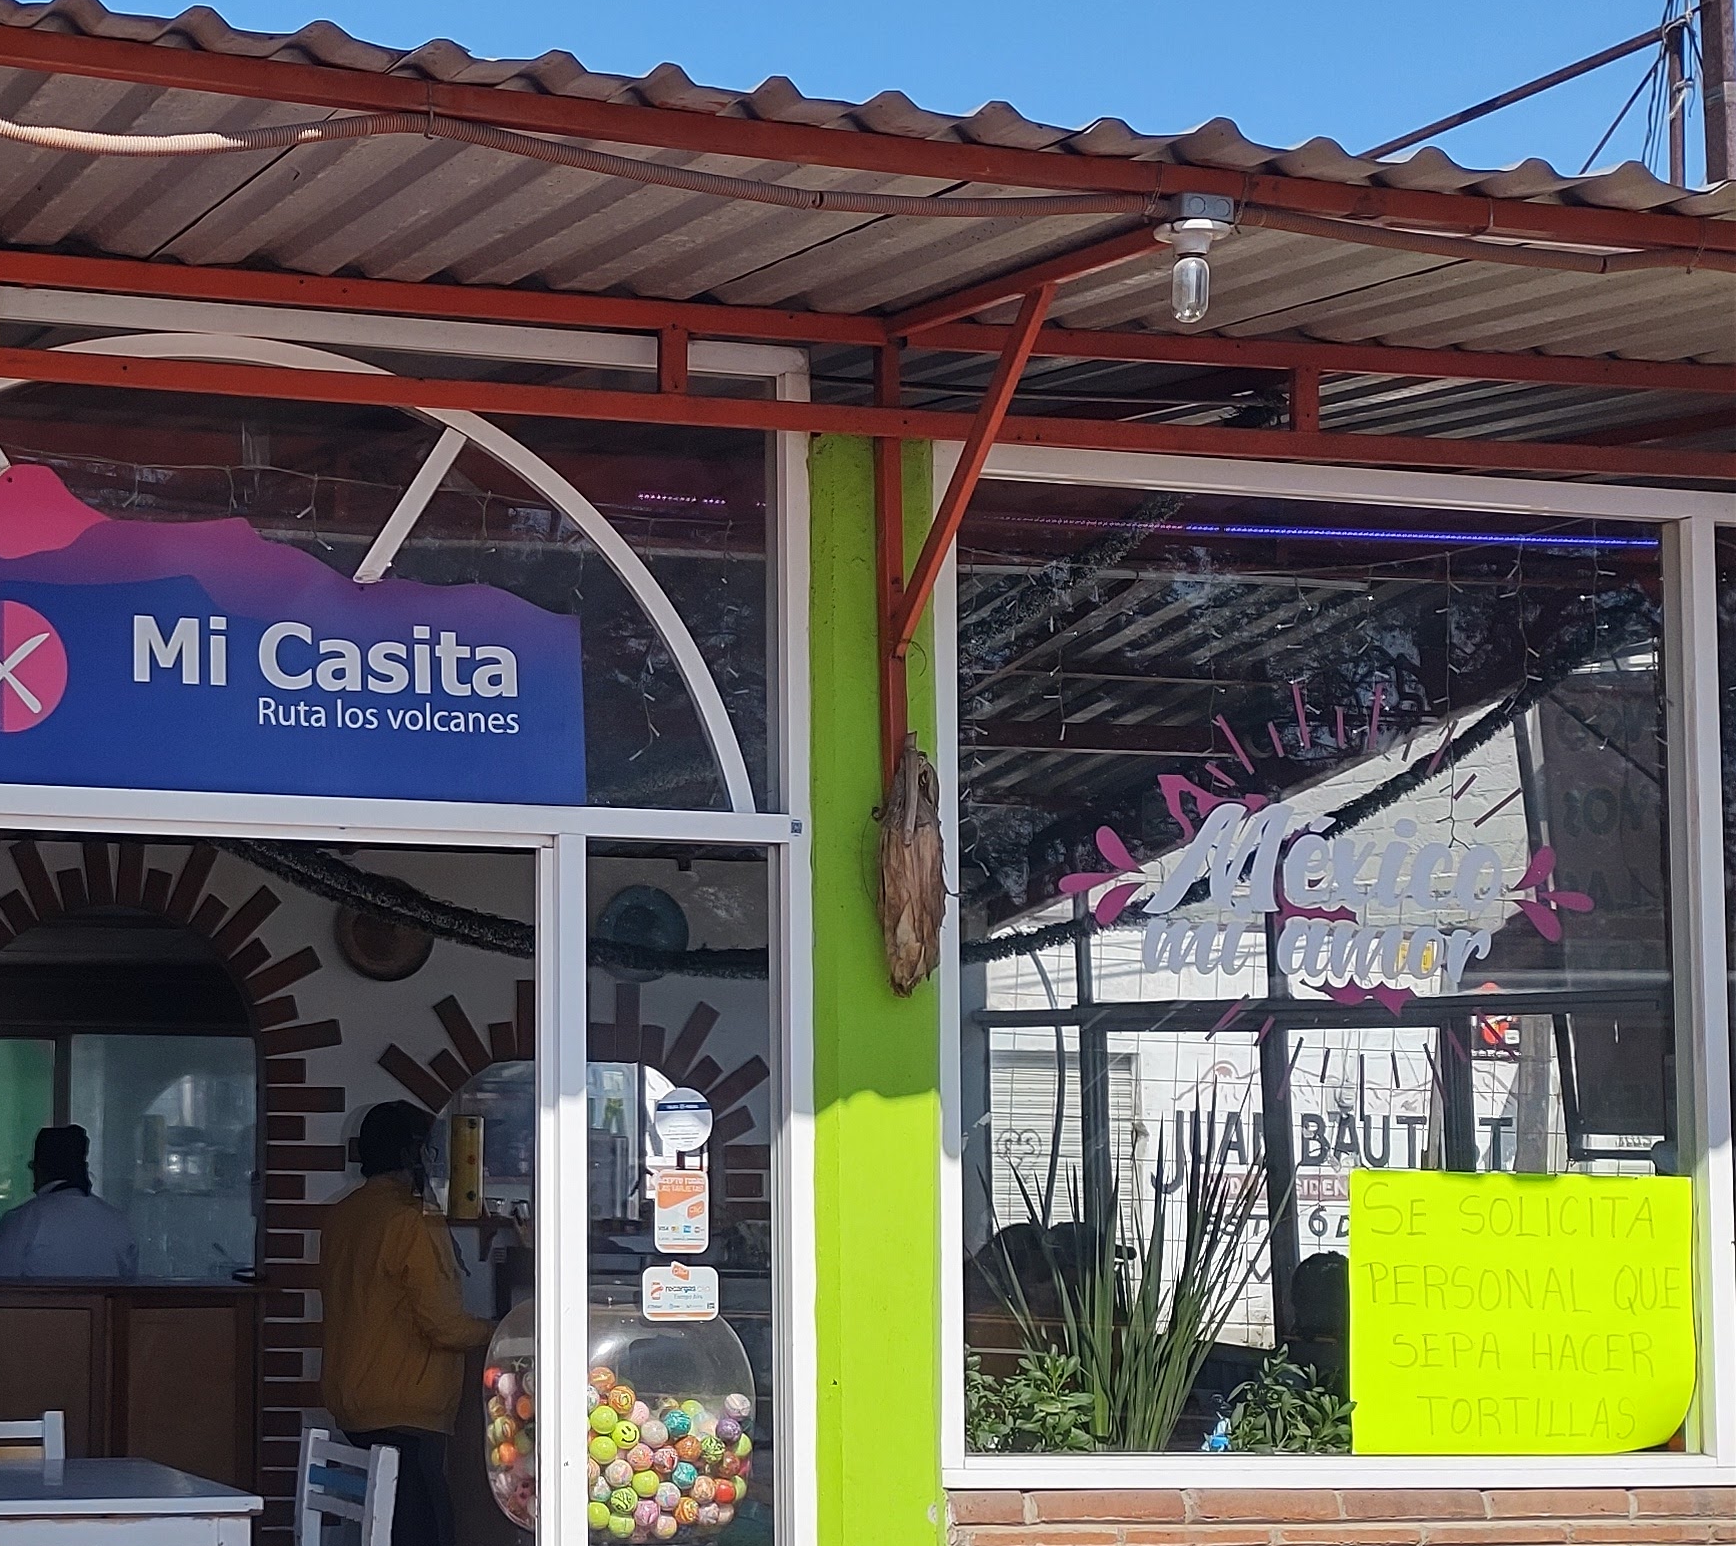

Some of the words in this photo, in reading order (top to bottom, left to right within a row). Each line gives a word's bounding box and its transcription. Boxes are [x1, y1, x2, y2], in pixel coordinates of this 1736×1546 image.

[133, 614, 228, 687] Mi
[257, 620, 520, 698] Casita
[257, 696, 328, 728] Ruta
[336, 698, 380, 731] los
[386, 702, 521, 735] volcanes
[1141, 801, 1503, 918] México
[1143, 908, 1254, 976] mi
[1276, 915, 1493, 984] amor
[1363, 1181, 1427, 1236] SE
[1459, 1195, 1655, 1239] SOLICITA
[1358, 1261, 1593, 1314] PERSONAL
[1613, 1264, 1682, 1316] QUE
[1389, 1331, 1502, 1371] SEPA
[1531, 1331, 1655, 1378] HACER
[1416, 1395, 1638, 1440] TORTILLAS
